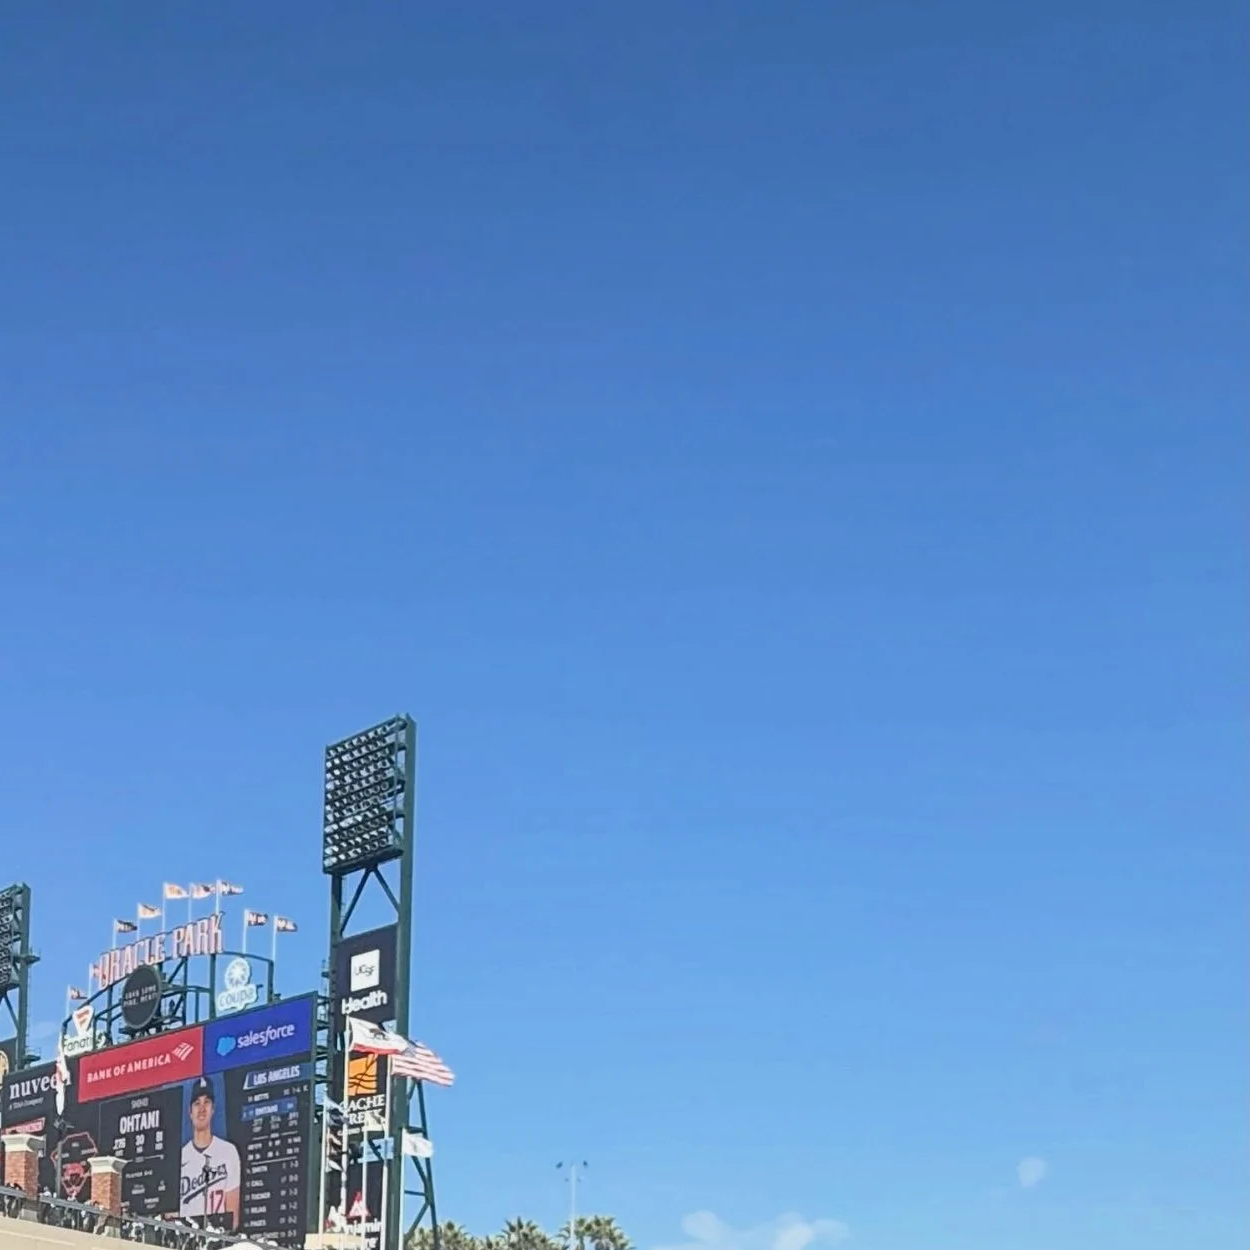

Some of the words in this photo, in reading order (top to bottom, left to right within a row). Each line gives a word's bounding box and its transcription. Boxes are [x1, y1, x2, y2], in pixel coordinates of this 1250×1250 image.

[99, 935, 165, 991] ORACLE
[173, 911, 226, 959] PARK
[219, 989, 254, 1008] coupa
[341, 989, 388, 1015] Health
[236, 1024, 295, 1048] salesforce
[86, 1069, 112, 1083] BANK
[113, 1066, 127, 1078] OF
[127, 1053, 171, 1074] AMERICA
[253, 1072, 267, 1086] LOS
[268, 1065, 300, 1083] ANGELES
[340, 1094, 385, 1112] ACHE
[119, 1110, 161, 1134] OHTANI
[181, 1163, 228, 1196] Dodrs
[209, 1189, 224, 1215] 17
